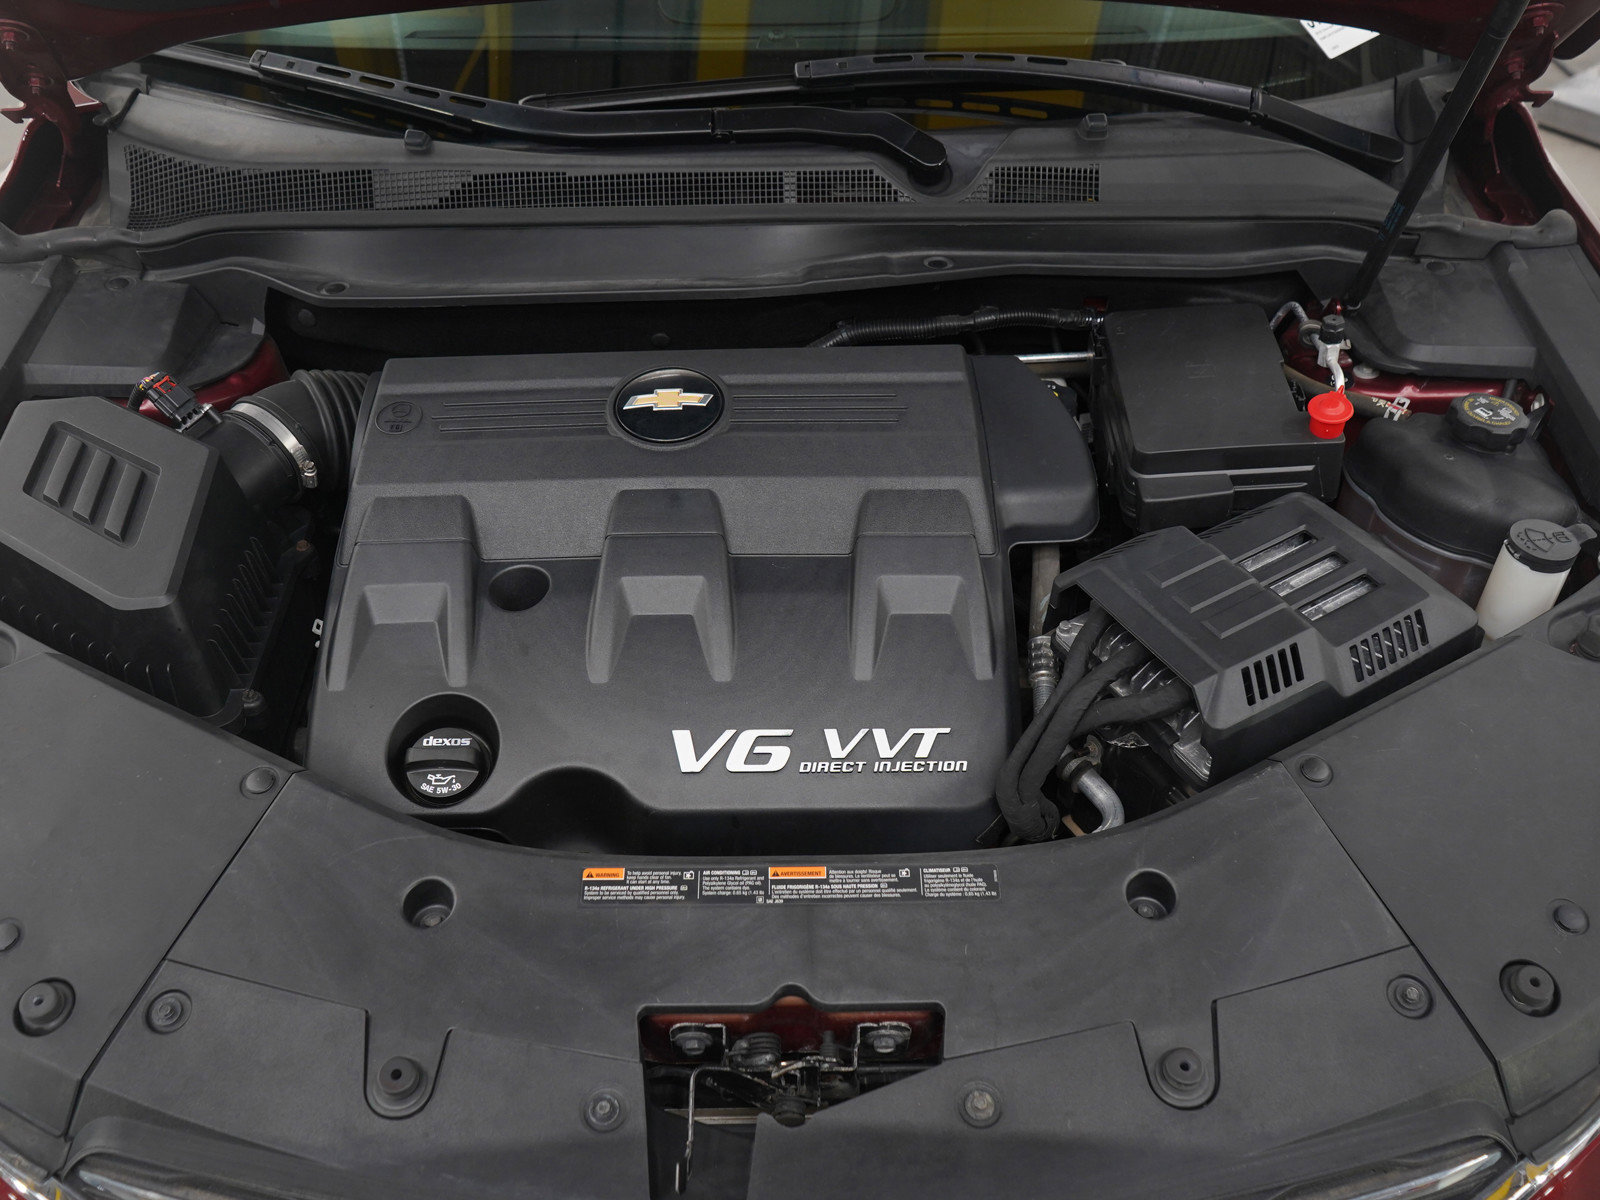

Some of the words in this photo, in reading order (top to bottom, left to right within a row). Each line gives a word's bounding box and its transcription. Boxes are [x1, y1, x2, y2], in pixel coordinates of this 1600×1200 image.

[422, 736, 473, 746] dexos
[671, 729, 794, 773] V6
[823, 727, 951, 759] VVT
[799, 761, 867, 773] DIRECT
[873, 760, 968, 772] INJECTION
[420, 783, 435, 793] SAE
[436, 783, 462, 794] 5W-30
